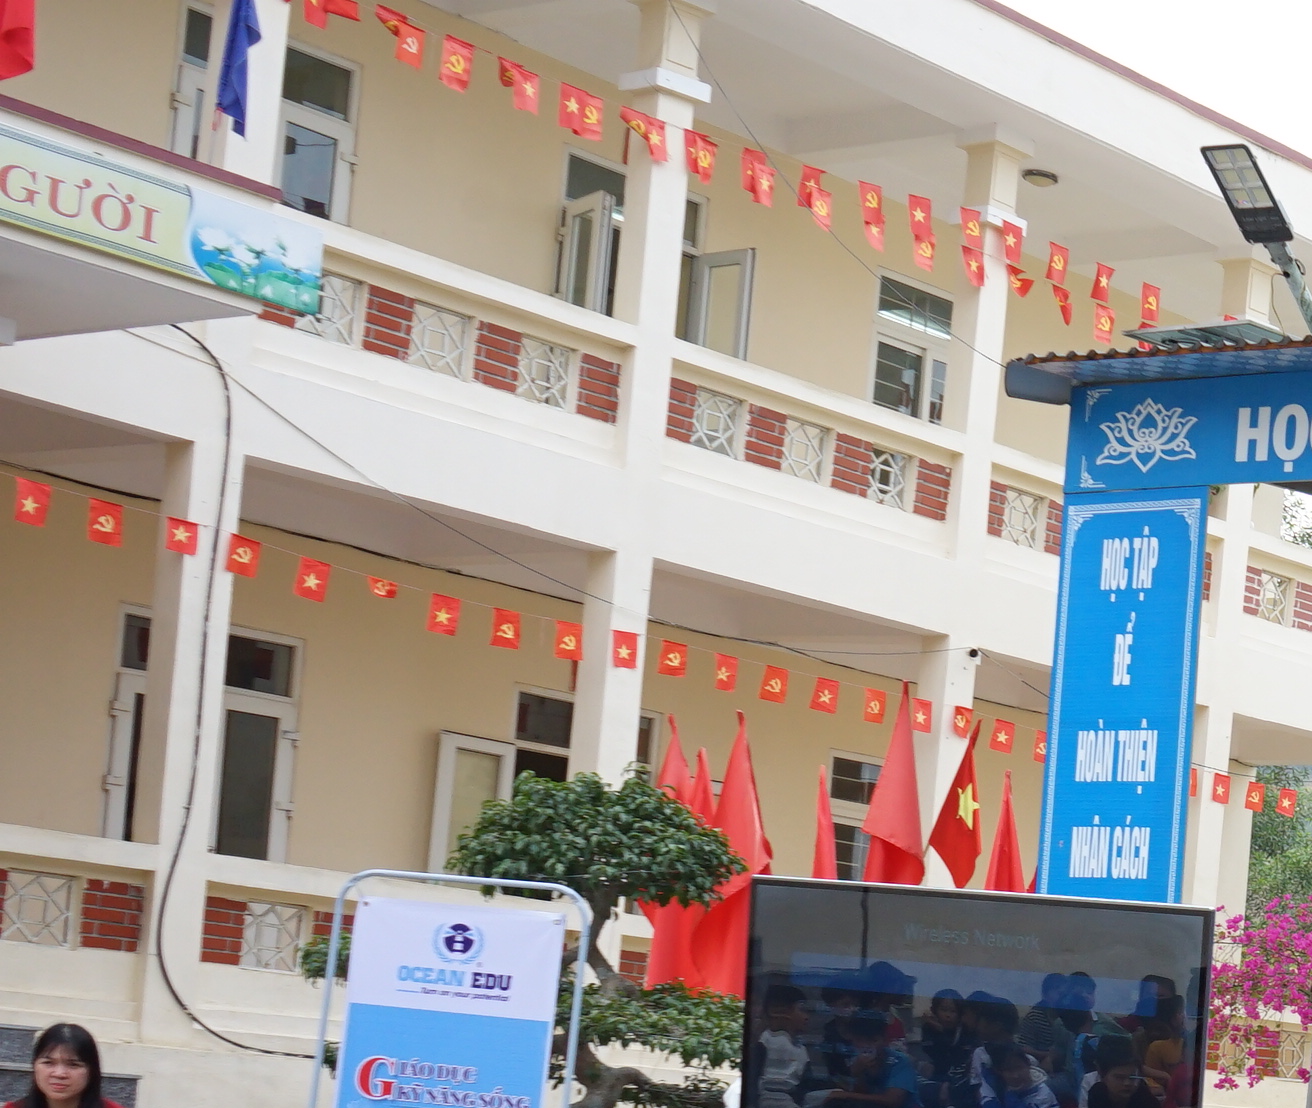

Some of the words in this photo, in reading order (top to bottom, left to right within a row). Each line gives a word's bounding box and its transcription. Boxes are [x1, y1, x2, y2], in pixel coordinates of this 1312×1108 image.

[0, 164, 161, 244] GƯỜI
[1100, 538, 1130, 602] HỌC
[1132, 525, 1159, 601] TẬP
[1112, 611, 1136, 686] ĐỂ
[1075, 718, 1115, 782] HOÀN
[1117, 718, 1158, 794] THIỆN
[1069, 815, 1110, 878] NHÂN
[1111, 815, 1150, 880] CÁCH
[904, 922, 969, 945] Wireless
[974, 929, 1040, 950] Network
[397, 965, 466, 987] OCEAN
[470, 971, 513, 991] EDU
